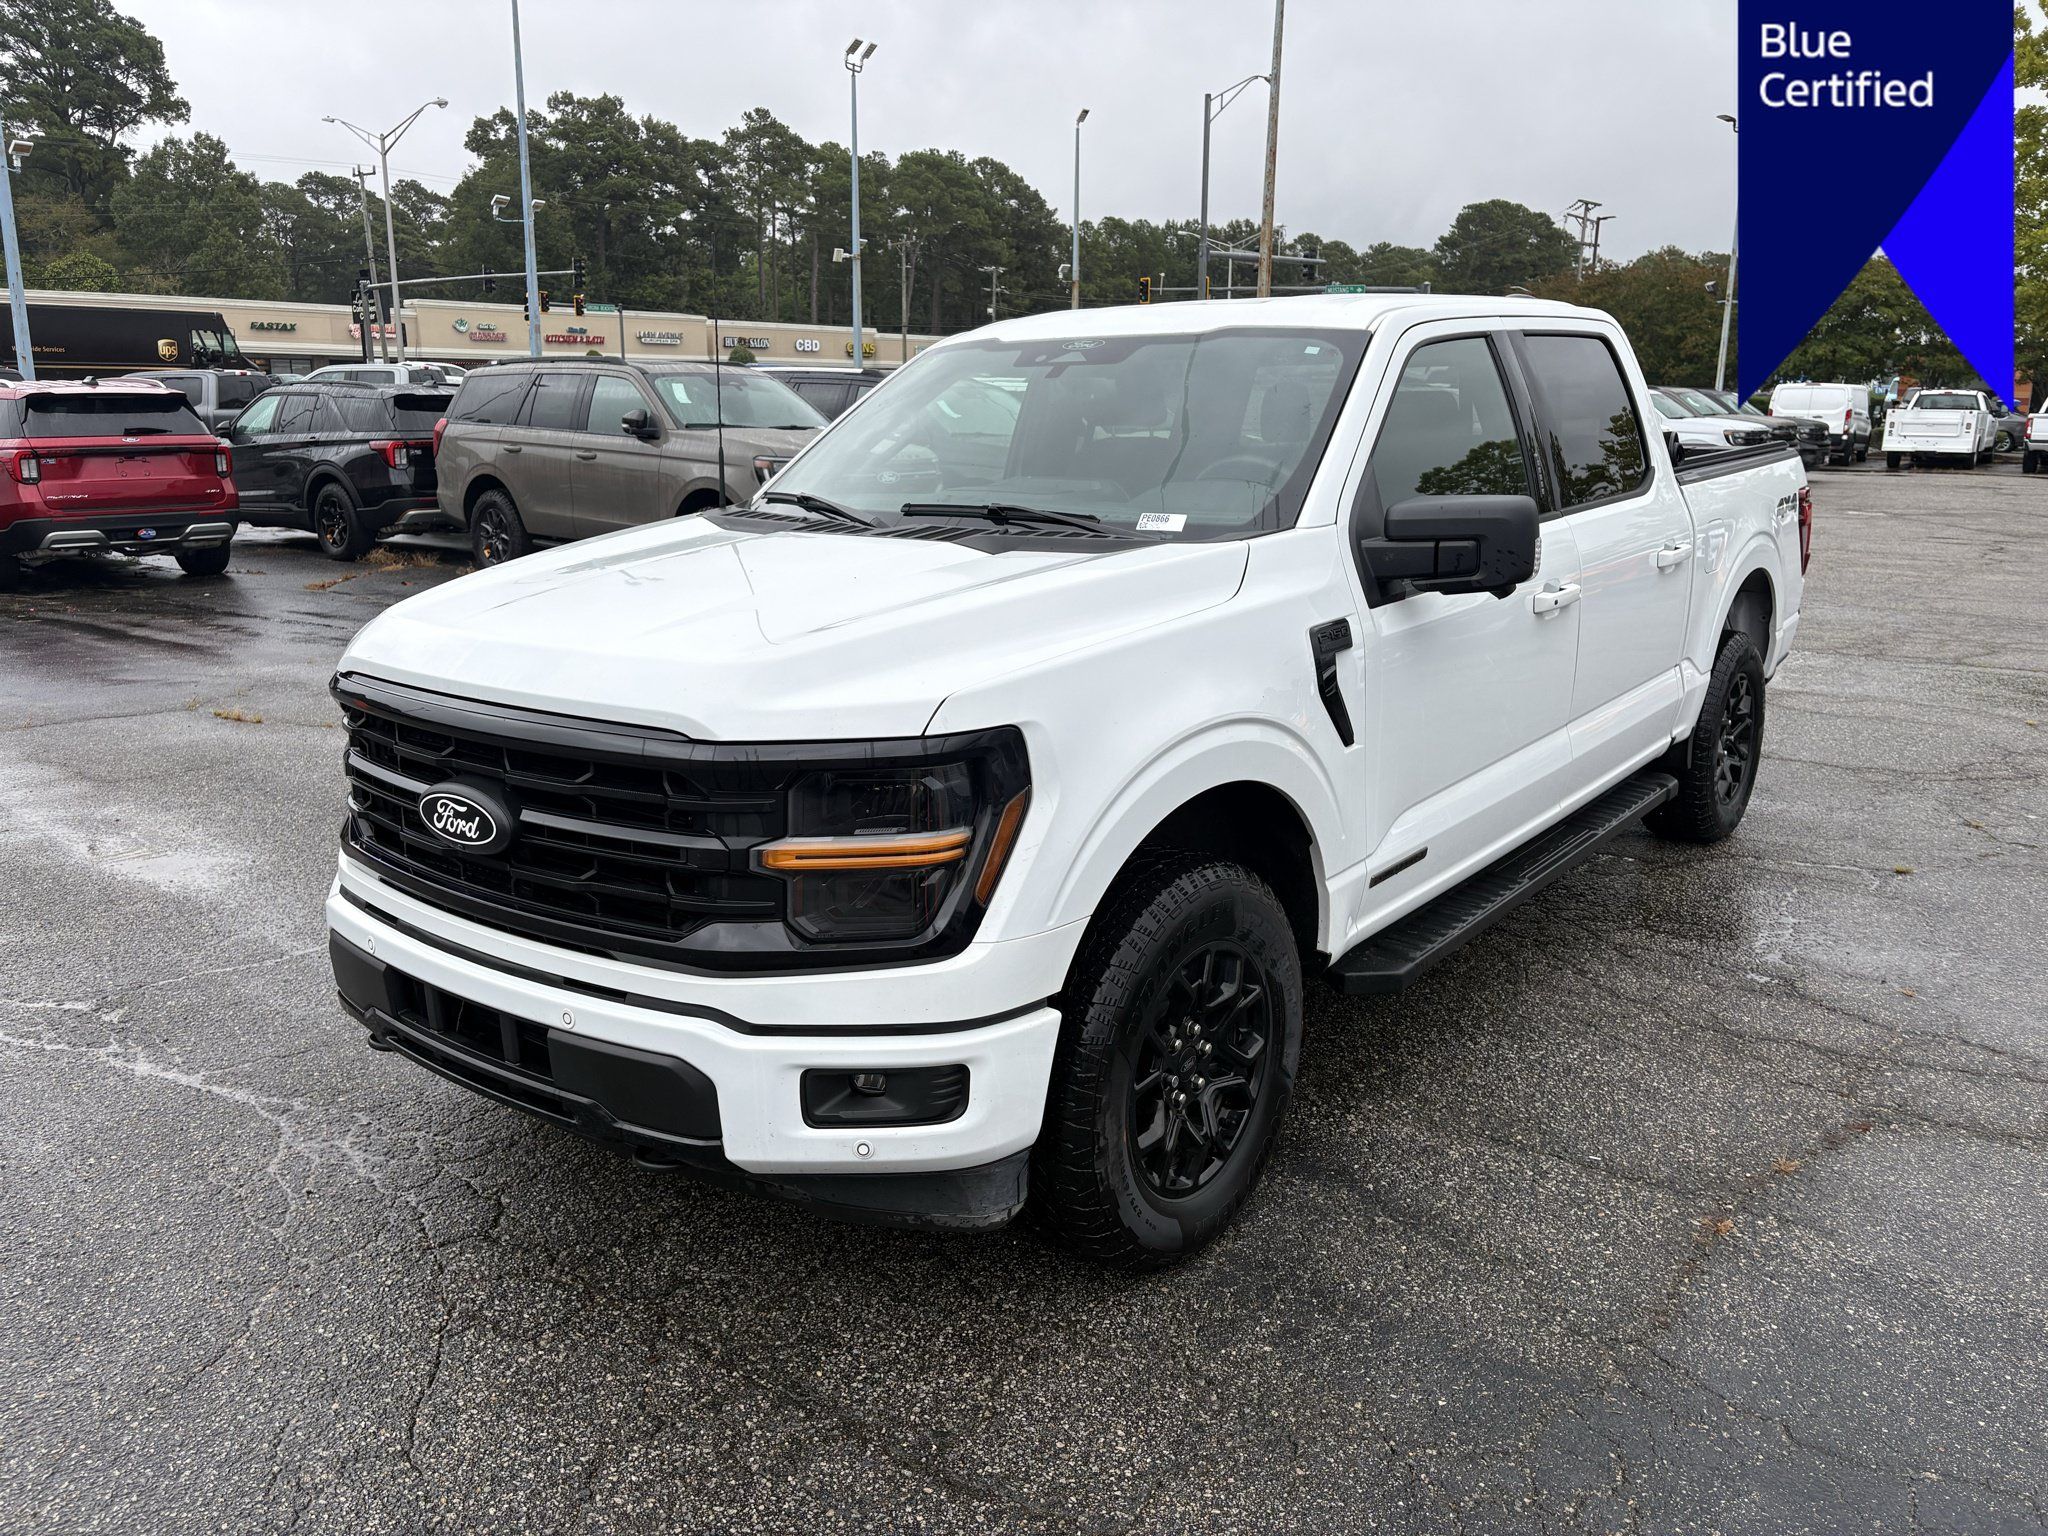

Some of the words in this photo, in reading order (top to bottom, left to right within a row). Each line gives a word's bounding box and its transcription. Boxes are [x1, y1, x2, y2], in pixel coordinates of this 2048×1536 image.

[250, 321, 297, 332] FASTAX
[749, 337, 770, 348] SALON
[795, 339, 820, 351] CBD
[846, 341, 876, 353] CNS
[160, 346, 177, 358] ups
[1141, 514, 1171, 523] PE0866
[434, 799, 480, 839] Ford
